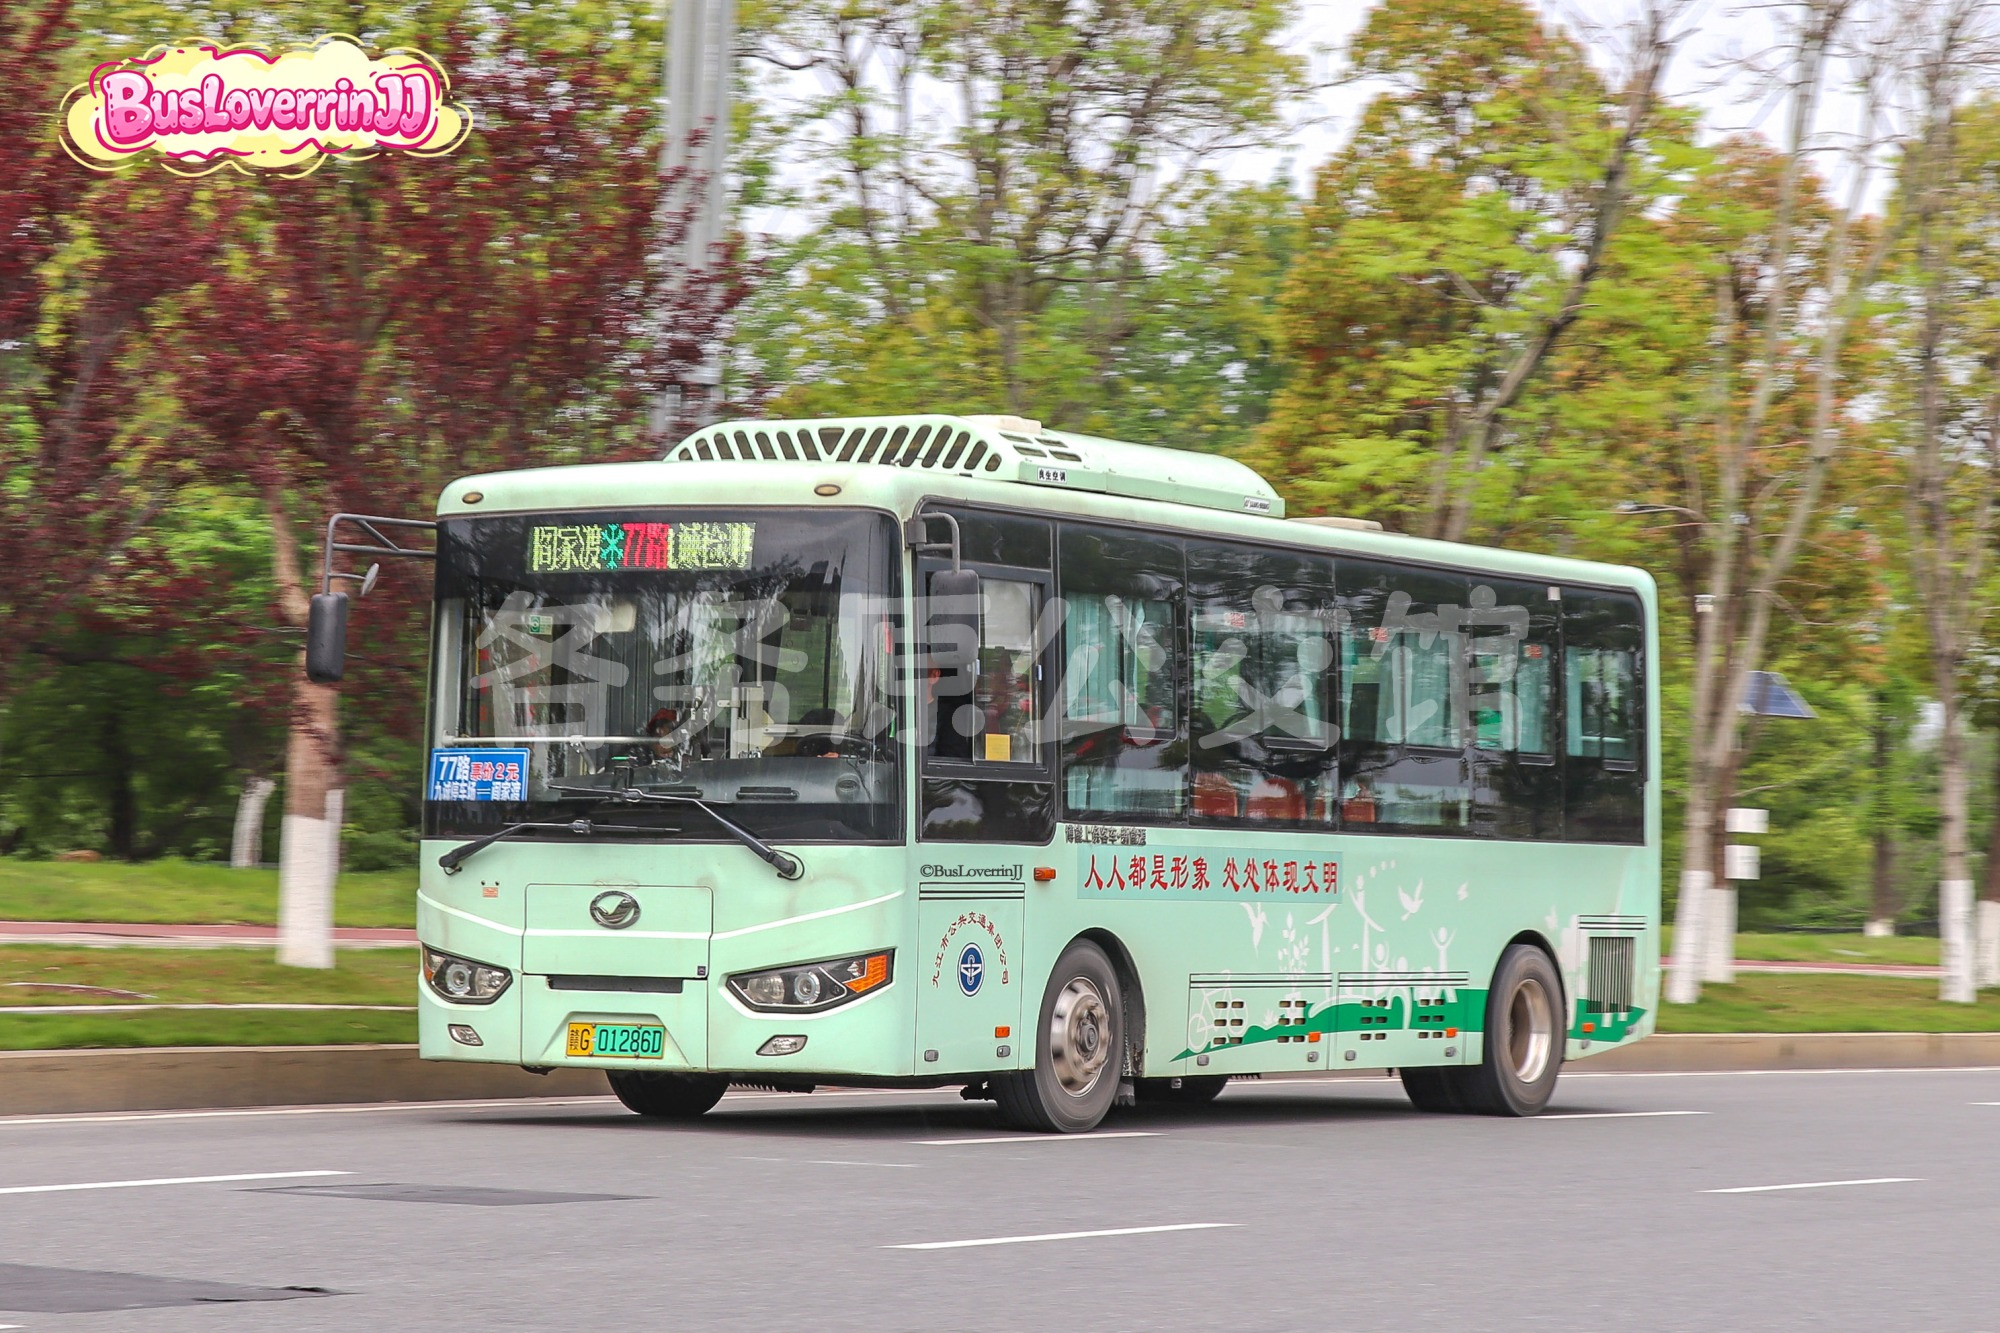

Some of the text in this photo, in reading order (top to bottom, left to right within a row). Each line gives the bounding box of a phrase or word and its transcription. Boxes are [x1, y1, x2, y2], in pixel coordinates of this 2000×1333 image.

[623, 522, 671, 569] 77路
[439, 755, 519, 781] 77路 票价2元
[1084, 854, 1339, 894] 人人都是形象 处处体现文明
